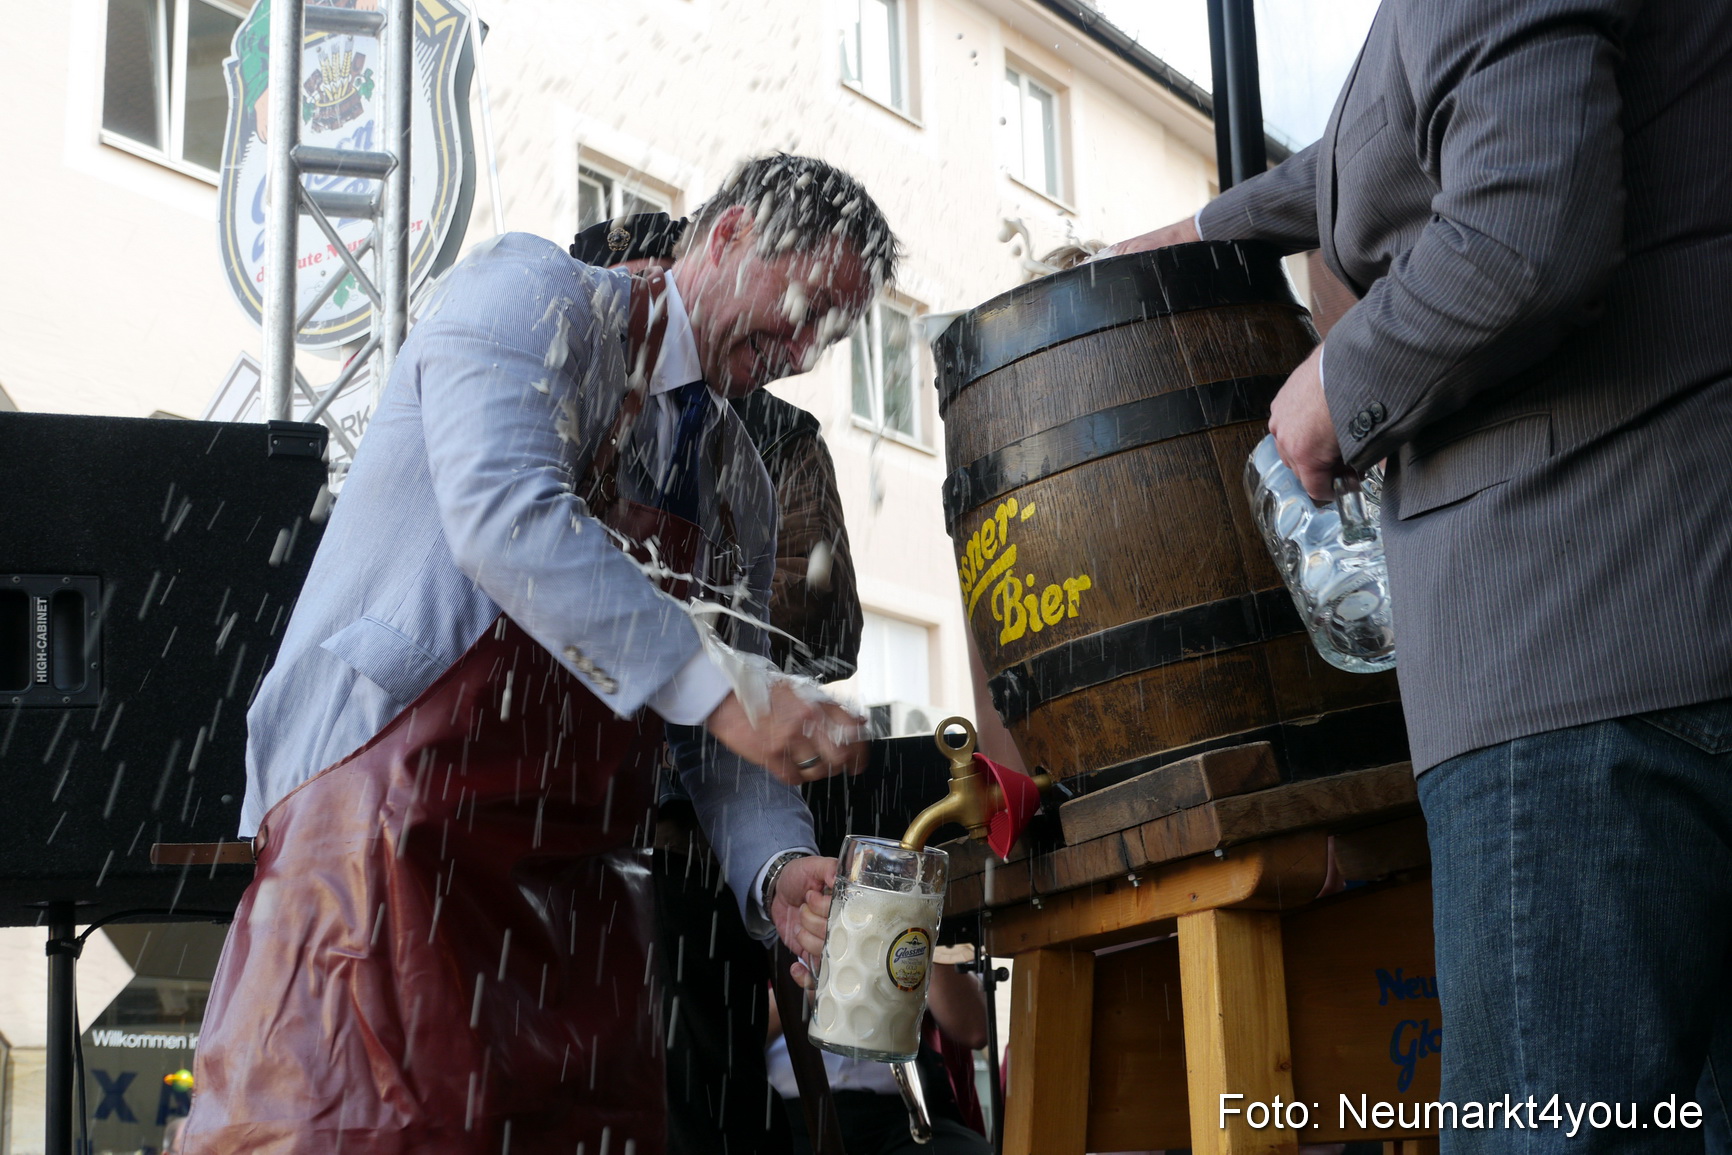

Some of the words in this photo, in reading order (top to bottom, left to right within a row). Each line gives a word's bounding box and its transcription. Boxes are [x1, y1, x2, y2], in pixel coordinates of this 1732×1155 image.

[36, 597, 48, 683] HIGH-CABINET
[991, 568, 1092, 647] Bier
[92, 1030, 186, 1049] Willkommen
